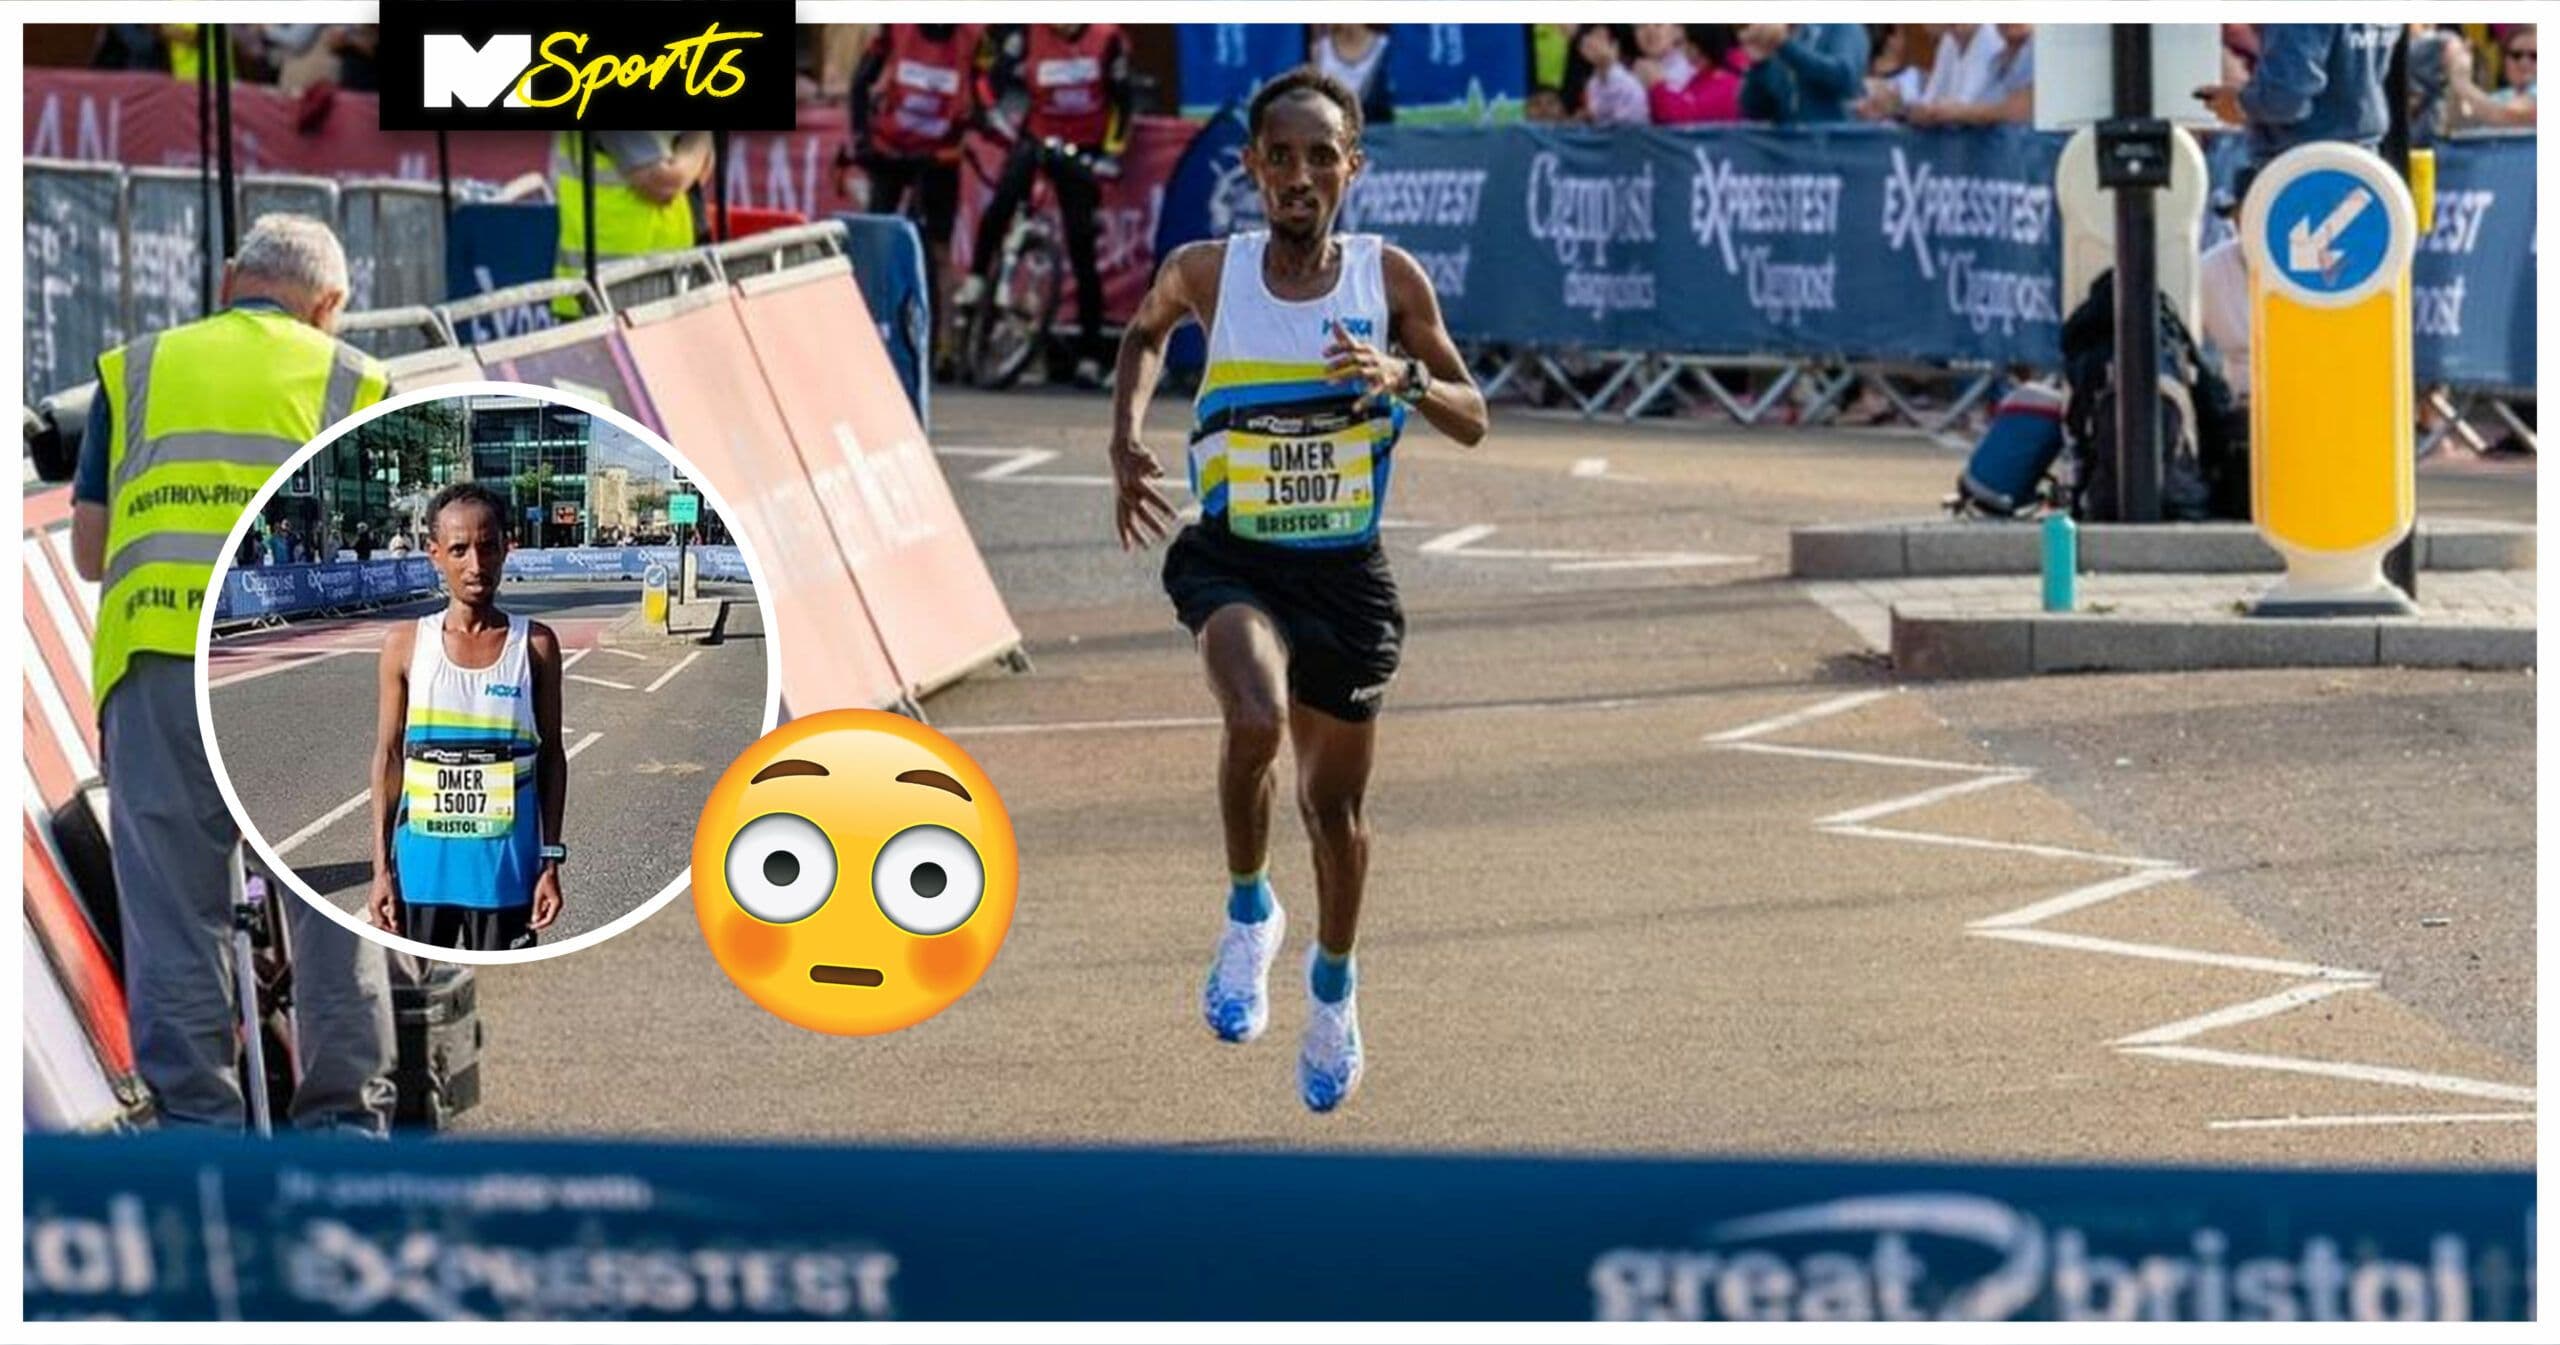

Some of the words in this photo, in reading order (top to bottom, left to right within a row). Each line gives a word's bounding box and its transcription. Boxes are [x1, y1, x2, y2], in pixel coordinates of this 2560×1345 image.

[1269, 440, 1335, 471] OMER
[1264, 474, 1341, 505] 15007
[1256, 513, 1330, 532] BRISTOL
[437, 769, 484, 790] OMER
[433, 793, 487, 814] 15007
[426, 819, 478, 833] BRISTOL
[2054, 1227, 2471, 1321] bristol
